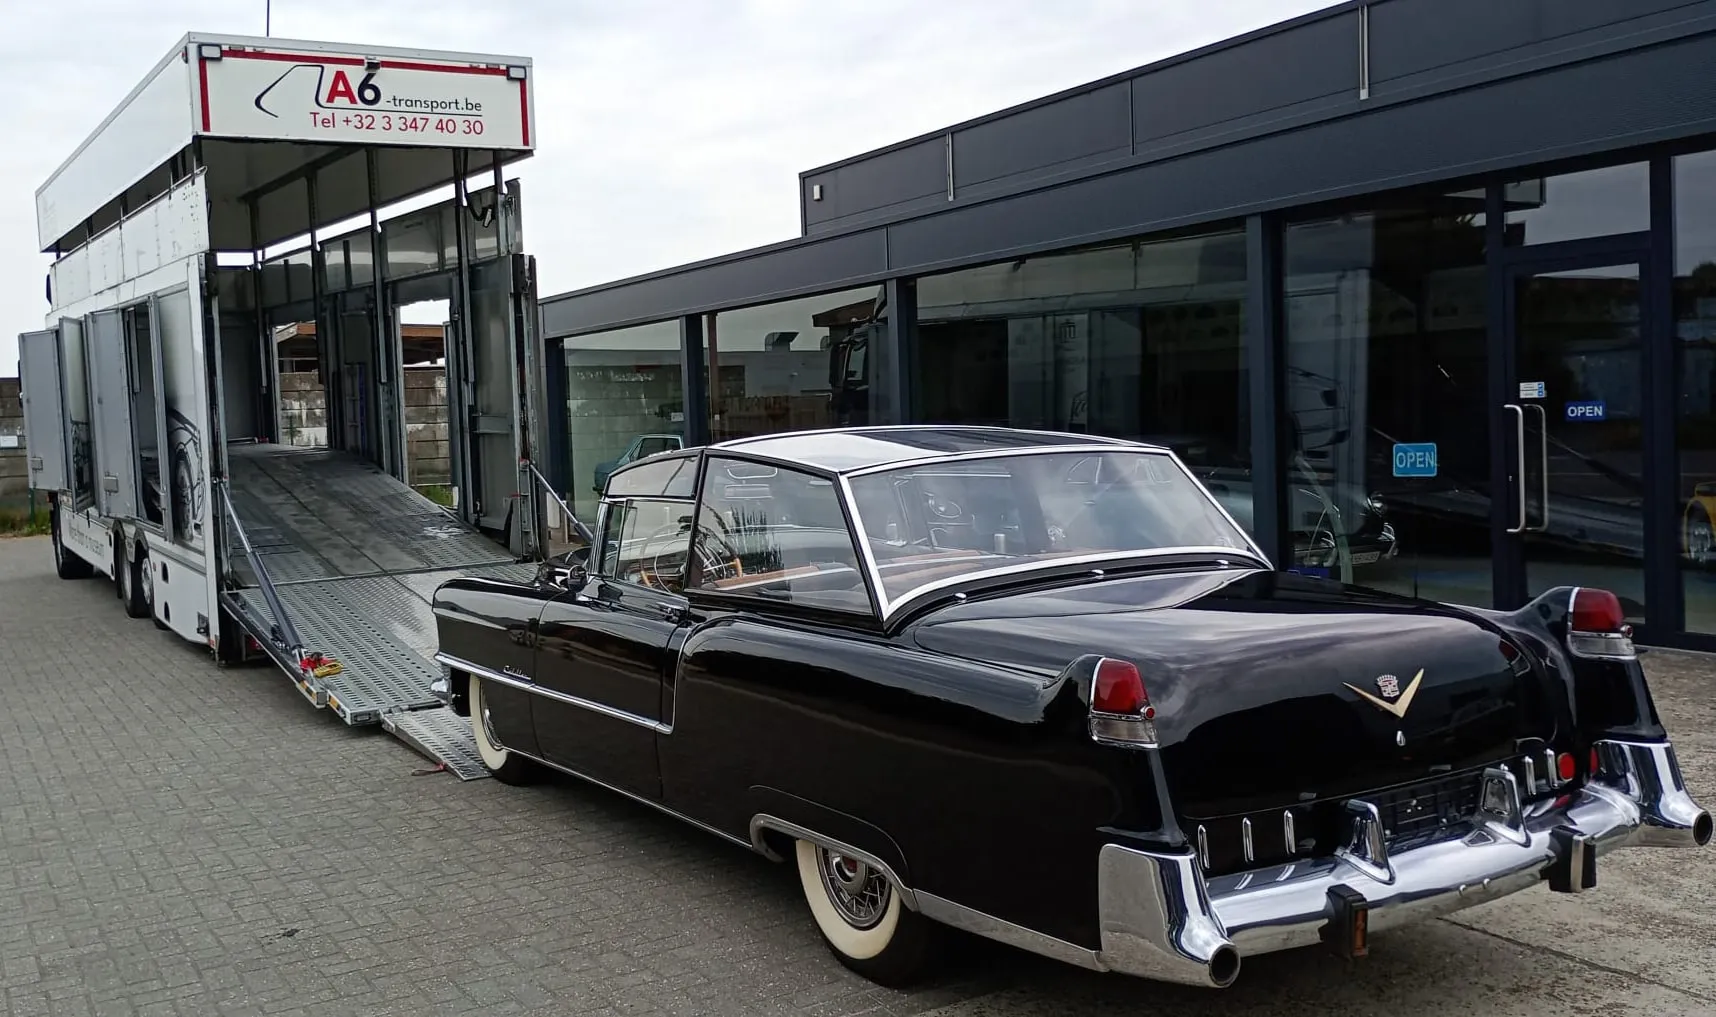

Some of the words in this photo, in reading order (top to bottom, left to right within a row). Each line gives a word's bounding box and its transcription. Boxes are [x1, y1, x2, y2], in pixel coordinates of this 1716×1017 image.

[310, 112, 336, 128] Tel
[342, 114, 375, 130] +32
[382, 115, 392, 131] 3
[398, 116, 429, 132] 347
[435, 118, 457, 134] 40
[462, 119, 483, 135] 30
[1567, 405, 1603, 417] OPEN
[1396, 451, 1434, 468] OPEN
